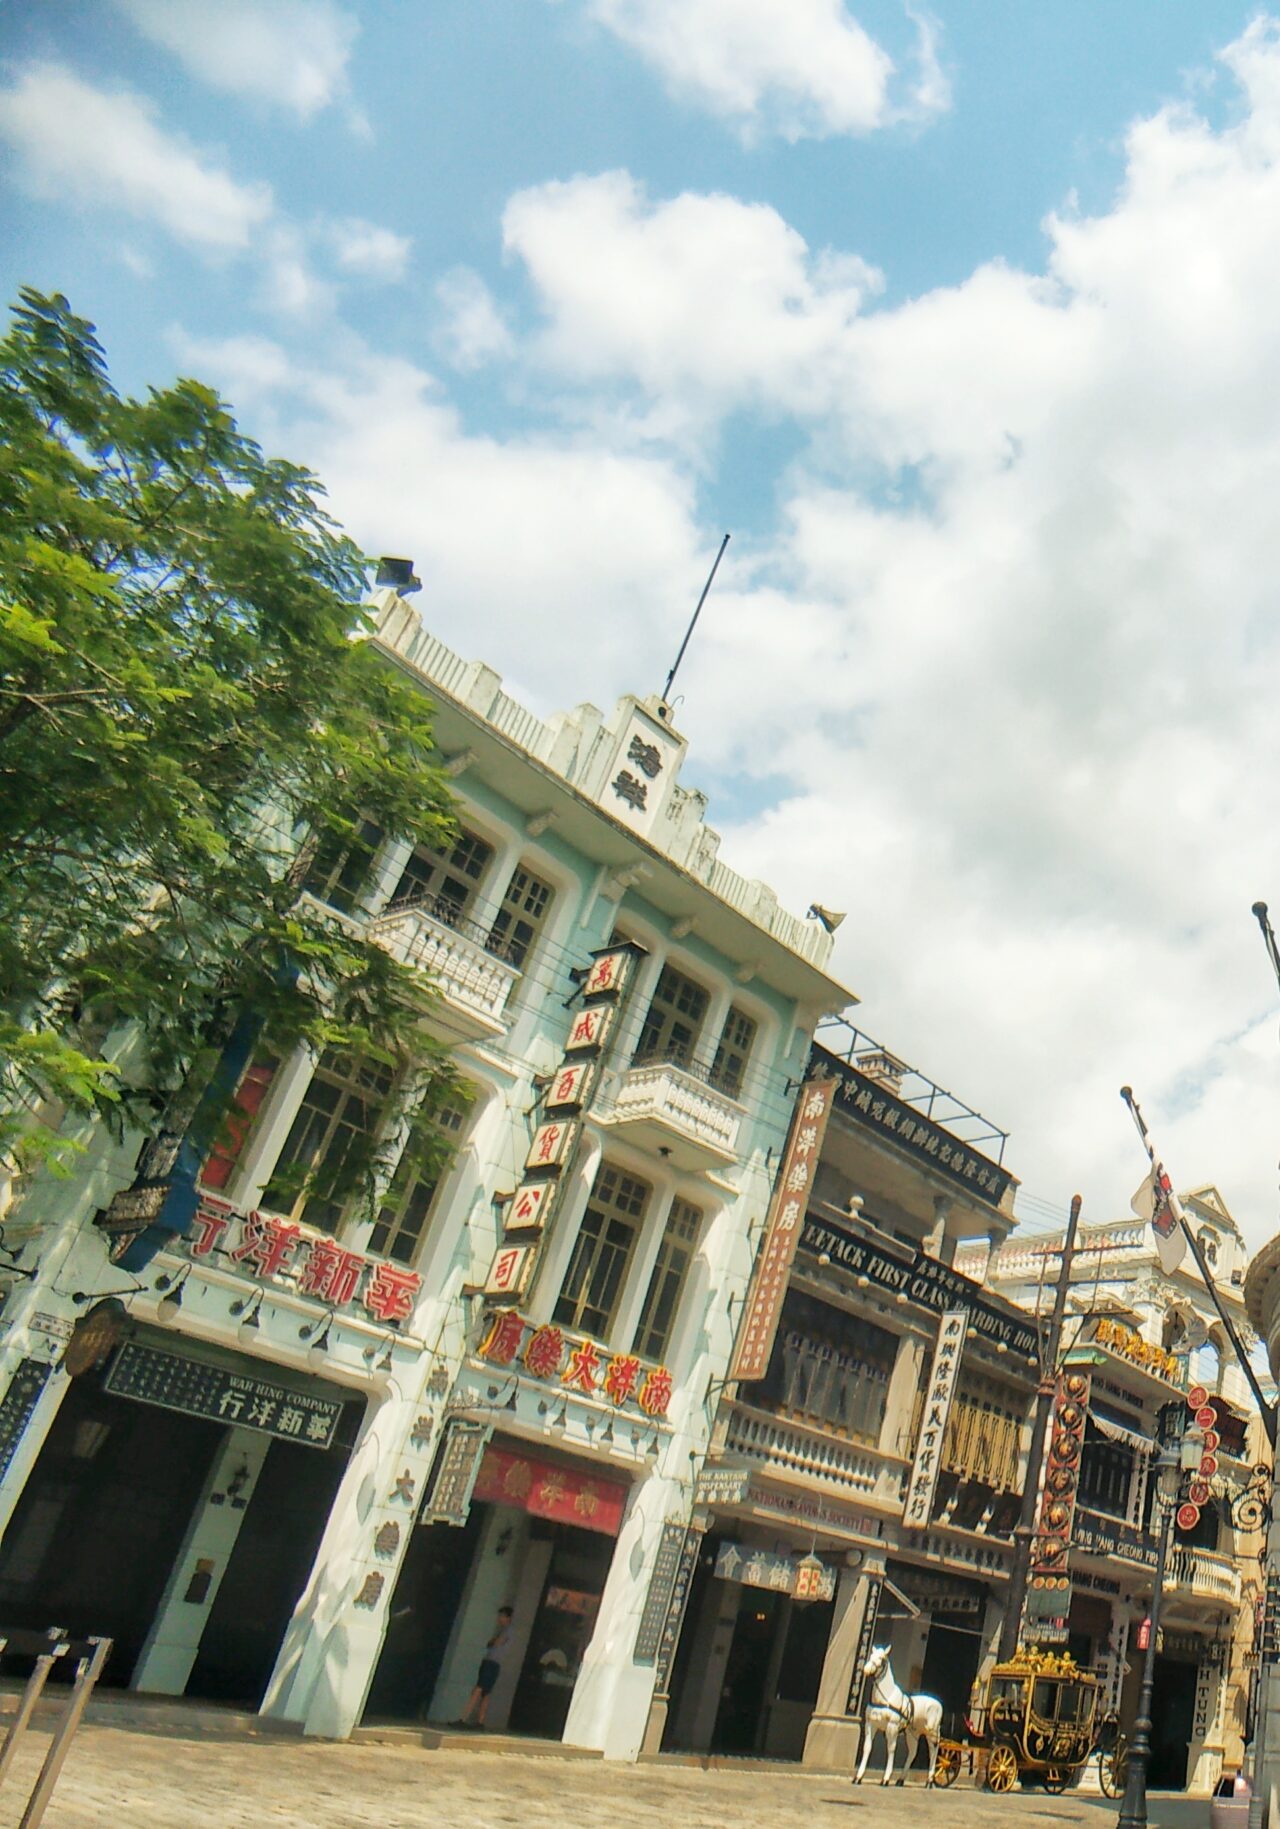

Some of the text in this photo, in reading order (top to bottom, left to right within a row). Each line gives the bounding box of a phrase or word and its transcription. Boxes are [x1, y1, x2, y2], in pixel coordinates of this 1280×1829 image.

[867, 1256, 912, 1290] FIRST
[911, 1279, 950, 1311] CLASS
[478, 1307, 673, 1415] 南洋大藥房
[218, 1390, 332, 1440] 華新洋行
[230, 1376, 338, 1416] WAH HING COMPANY
[719, 1545, 833, 1600] 萬儲蓄會
